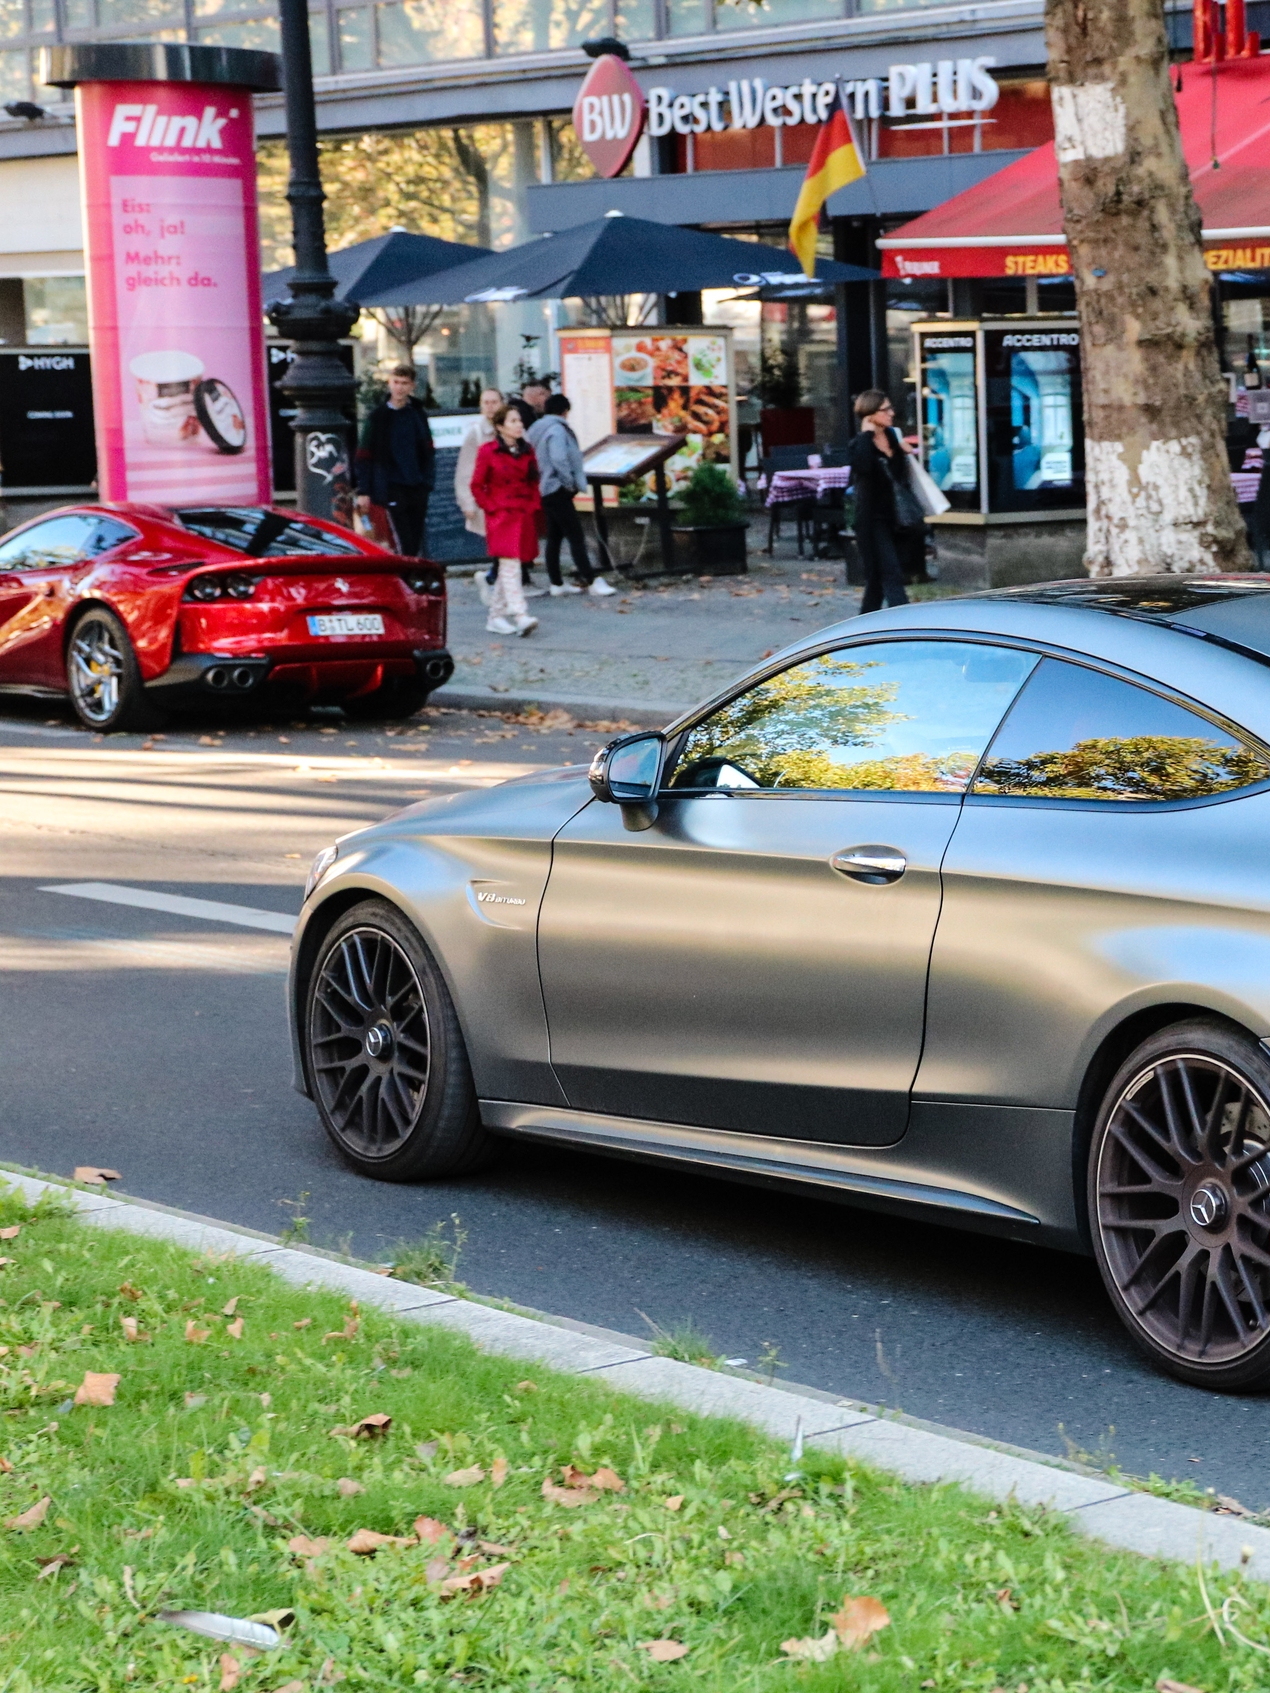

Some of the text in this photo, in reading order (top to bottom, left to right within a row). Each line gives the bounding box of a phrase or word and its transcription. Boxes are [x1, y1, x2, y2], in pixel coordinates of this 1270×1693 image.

[649, 56, 999, 137] Best Western PLUS
[582, 92, 632, 142] BW
[107, 104, 228, 149] Flink
[122, 199, 151, 214] Eis:
[123, 219, 185, 239] oh, ja!
[125, 250, 181, 266] Mehr:
[1005, 254, 1069, 276] STEAKS
[125, 270, 218, 292] gleich da.
[924, 337, 974, 348] ACCENTRO
[1002, 334, 1079, 347] ACCENTRO
[33, 356, 75, 370] HYGH
[317, 617, 381, 632] B TL 600
[477, 892, 496, 902] V8
